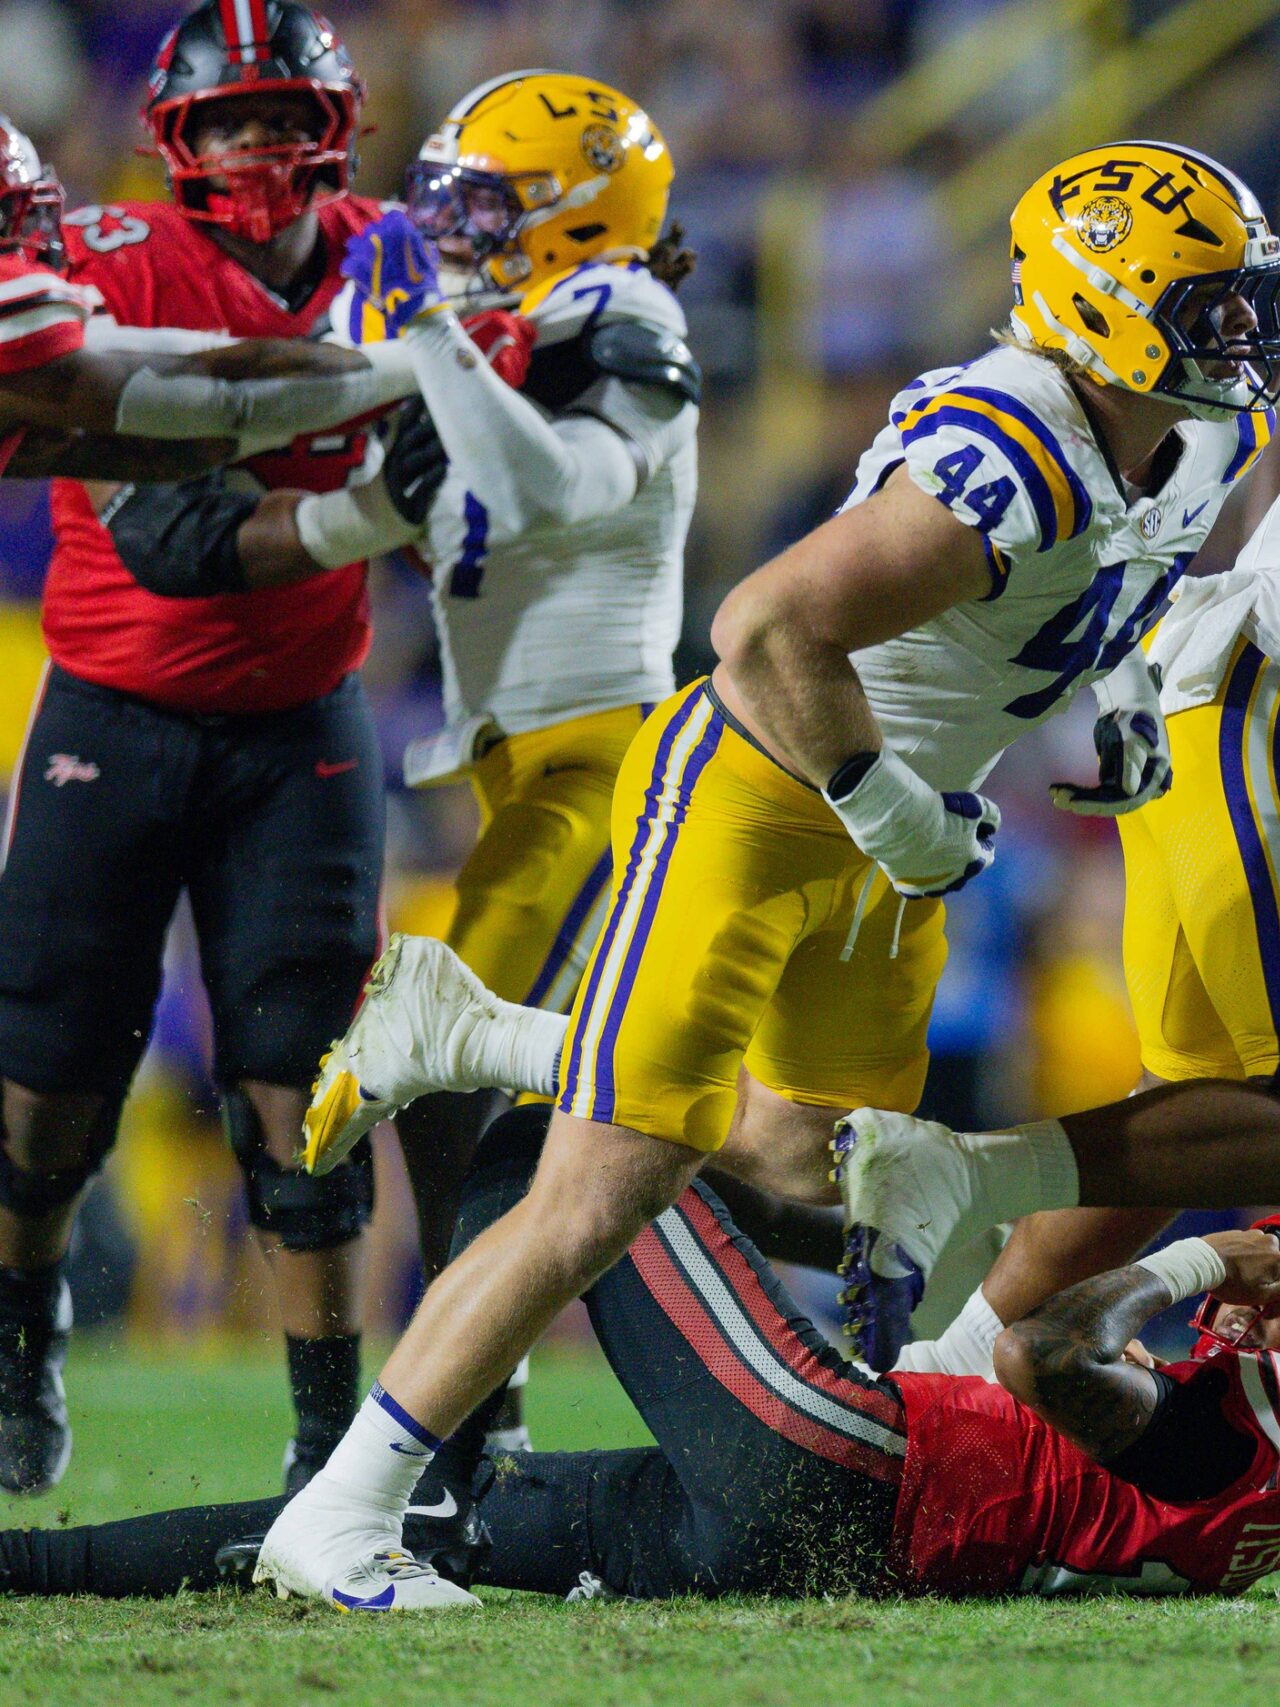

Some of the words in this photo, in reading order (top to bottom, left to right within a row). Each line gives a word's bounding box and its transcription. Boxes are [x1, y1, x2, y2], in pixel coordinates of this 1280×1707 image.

[1047, 159, 1196, 215] LSU
[573, 283, 612, 336] 7
[932, 443, 1018, 534] 44
[1001, 551, 1200, 720] 44
